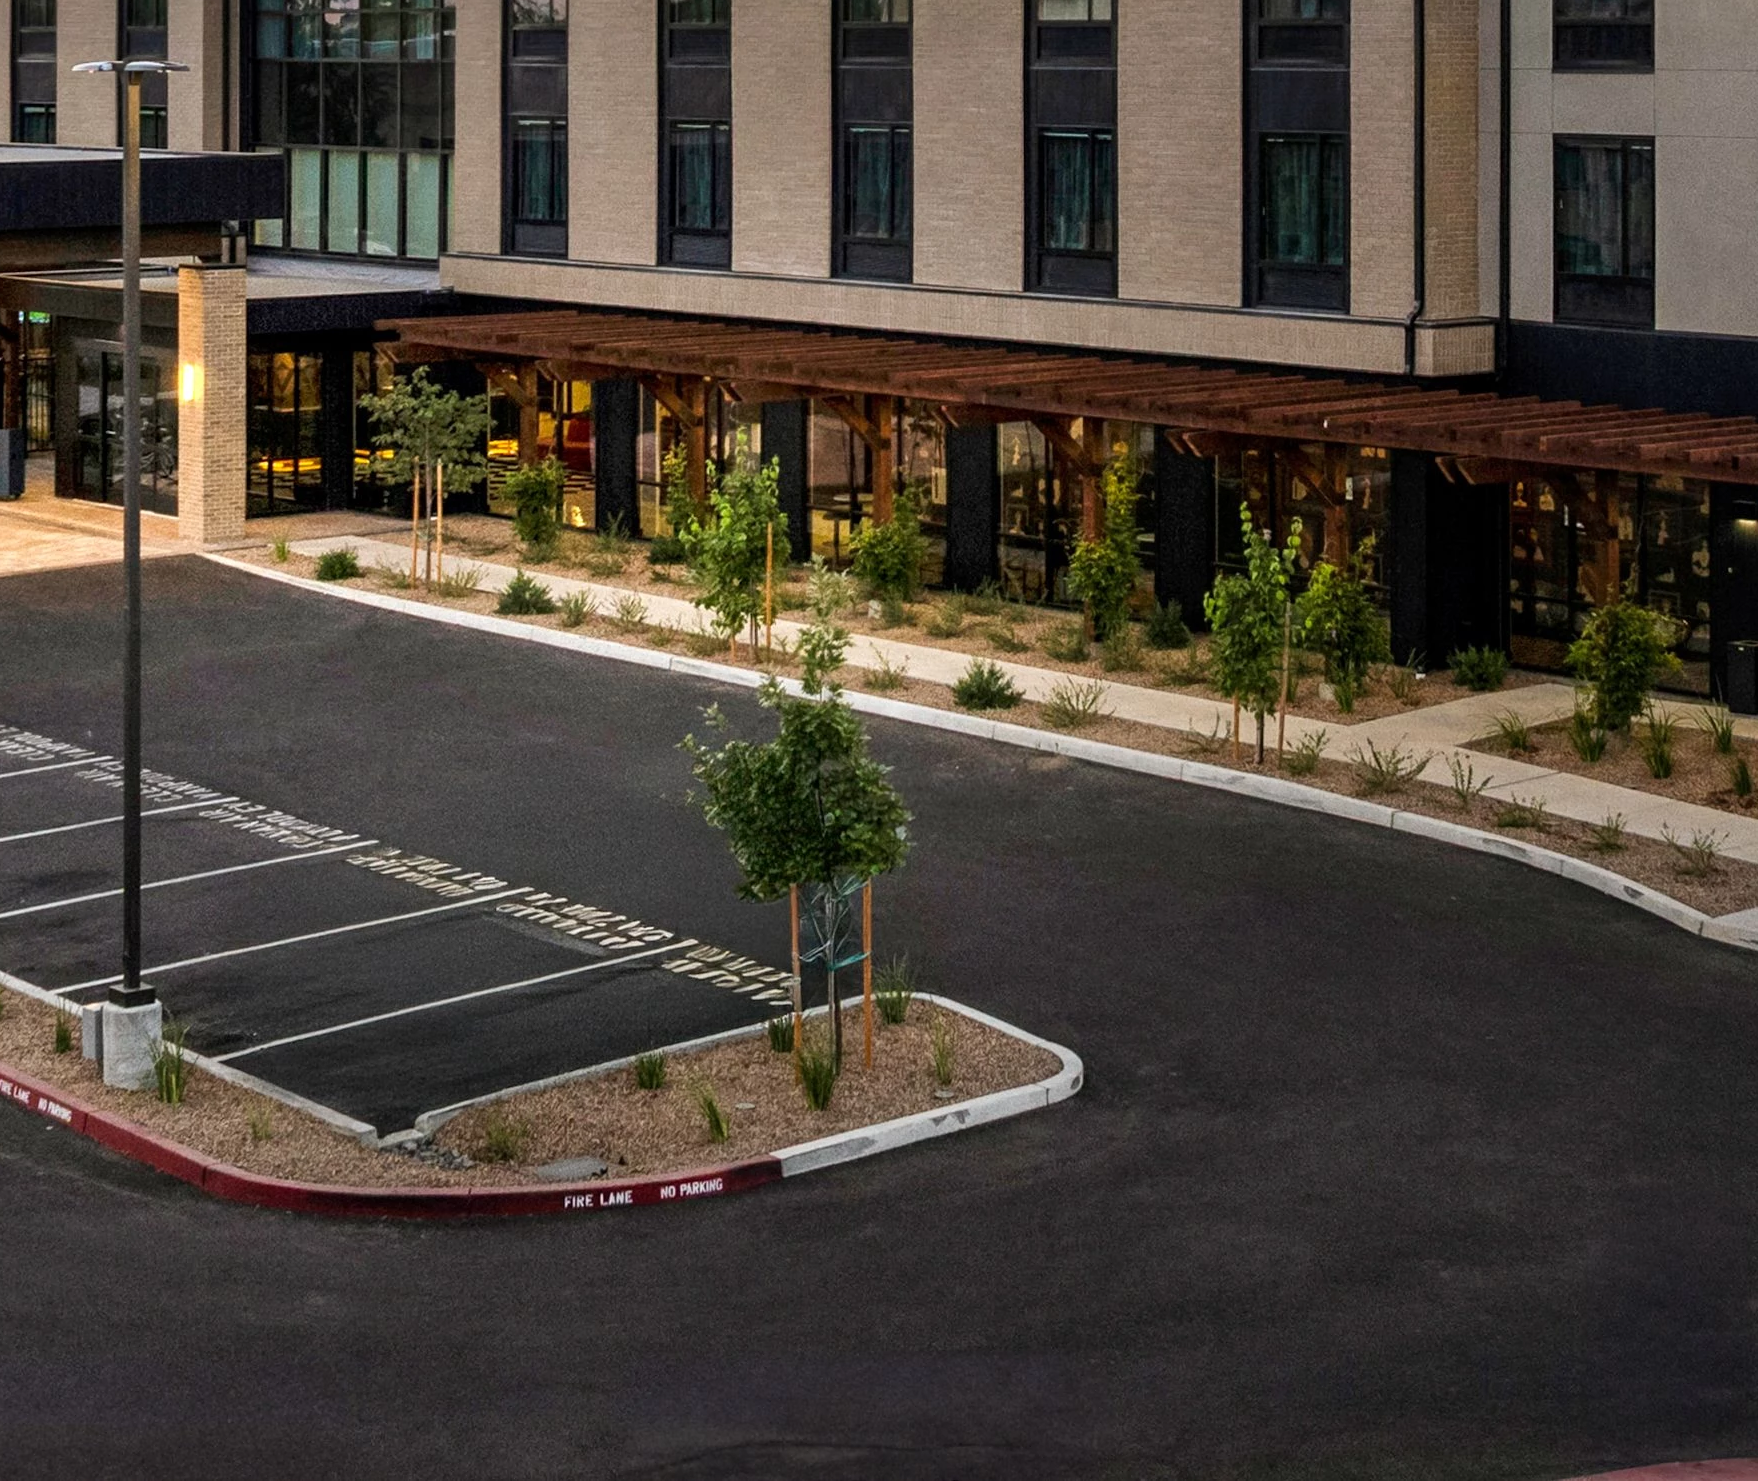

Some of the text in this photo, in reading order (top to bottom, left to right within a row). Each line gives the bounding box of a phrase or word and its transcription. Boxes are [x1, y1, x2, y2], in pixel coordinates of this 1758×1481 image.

[564, 1178, 723, 1209] FIRE LANE NO PARKING
